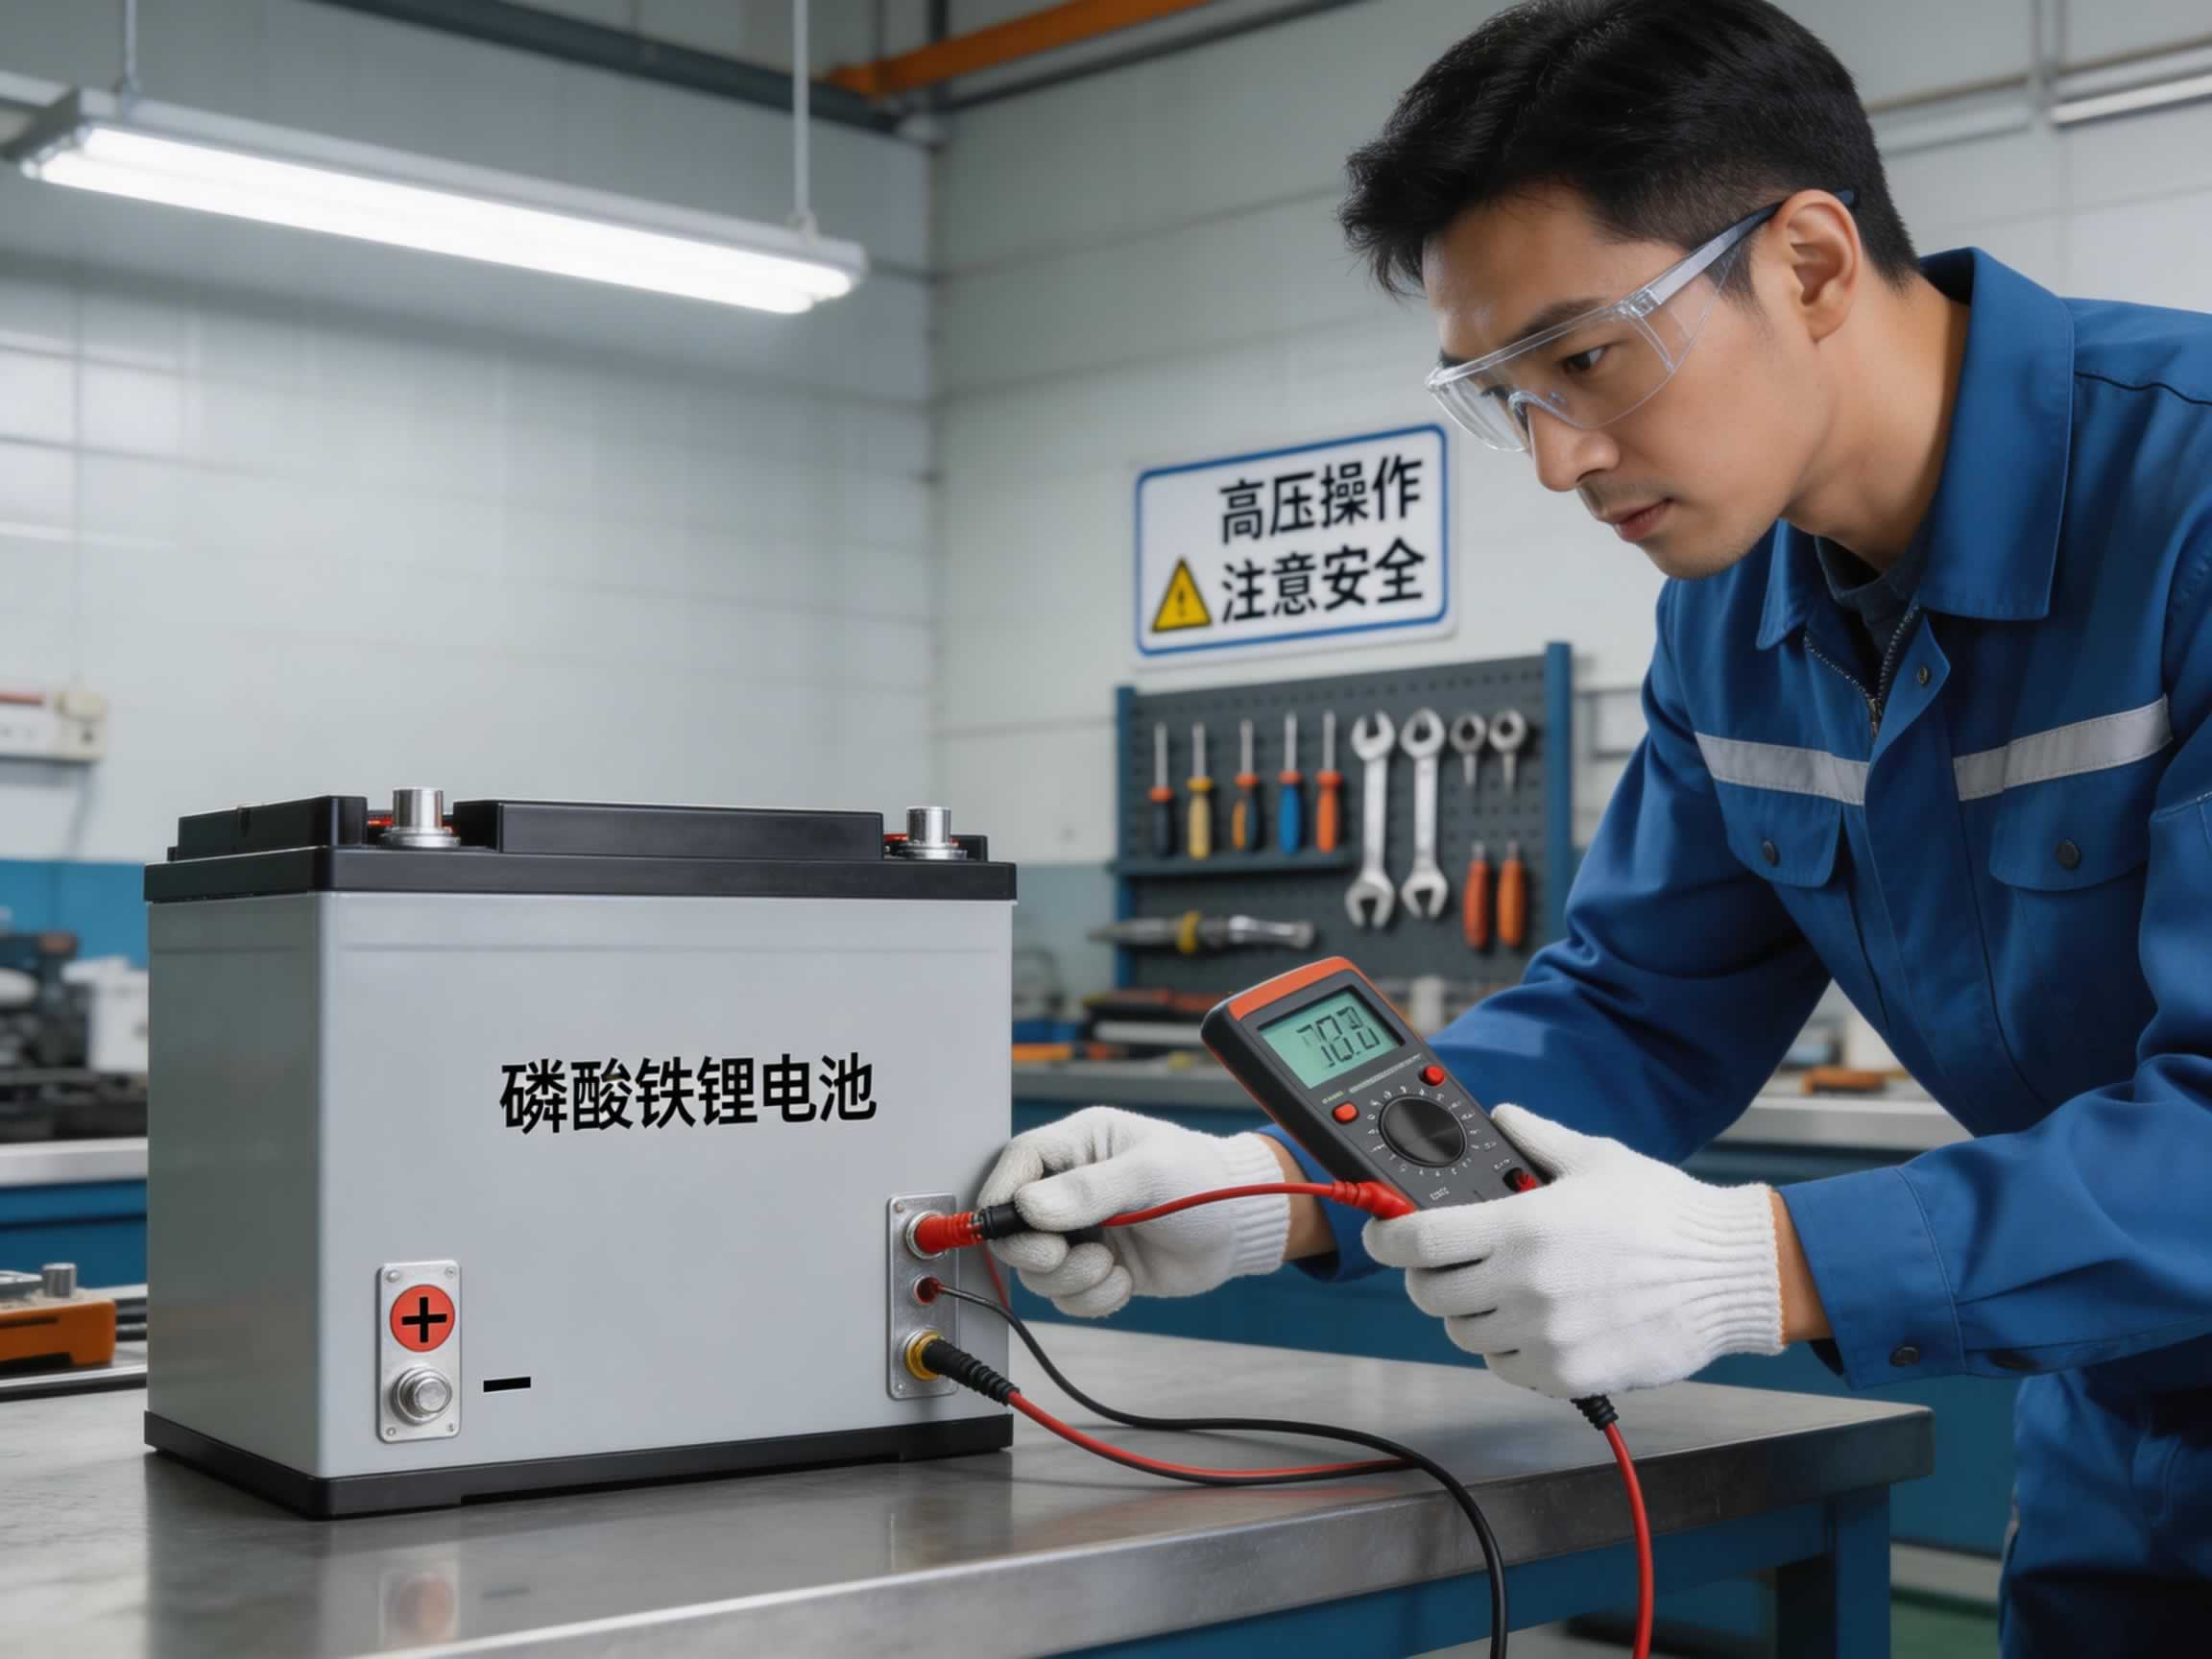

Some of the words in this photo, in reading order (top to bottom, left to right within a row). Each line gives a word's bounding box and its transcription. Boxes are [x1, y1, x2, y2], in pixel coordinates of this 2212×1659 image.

[1220, 454, 1423, 544] 高压操作
[1221, 537, 1426, 624] 注意安全
[499, 1051, 877, 1135] 磷酸铁锂电池
